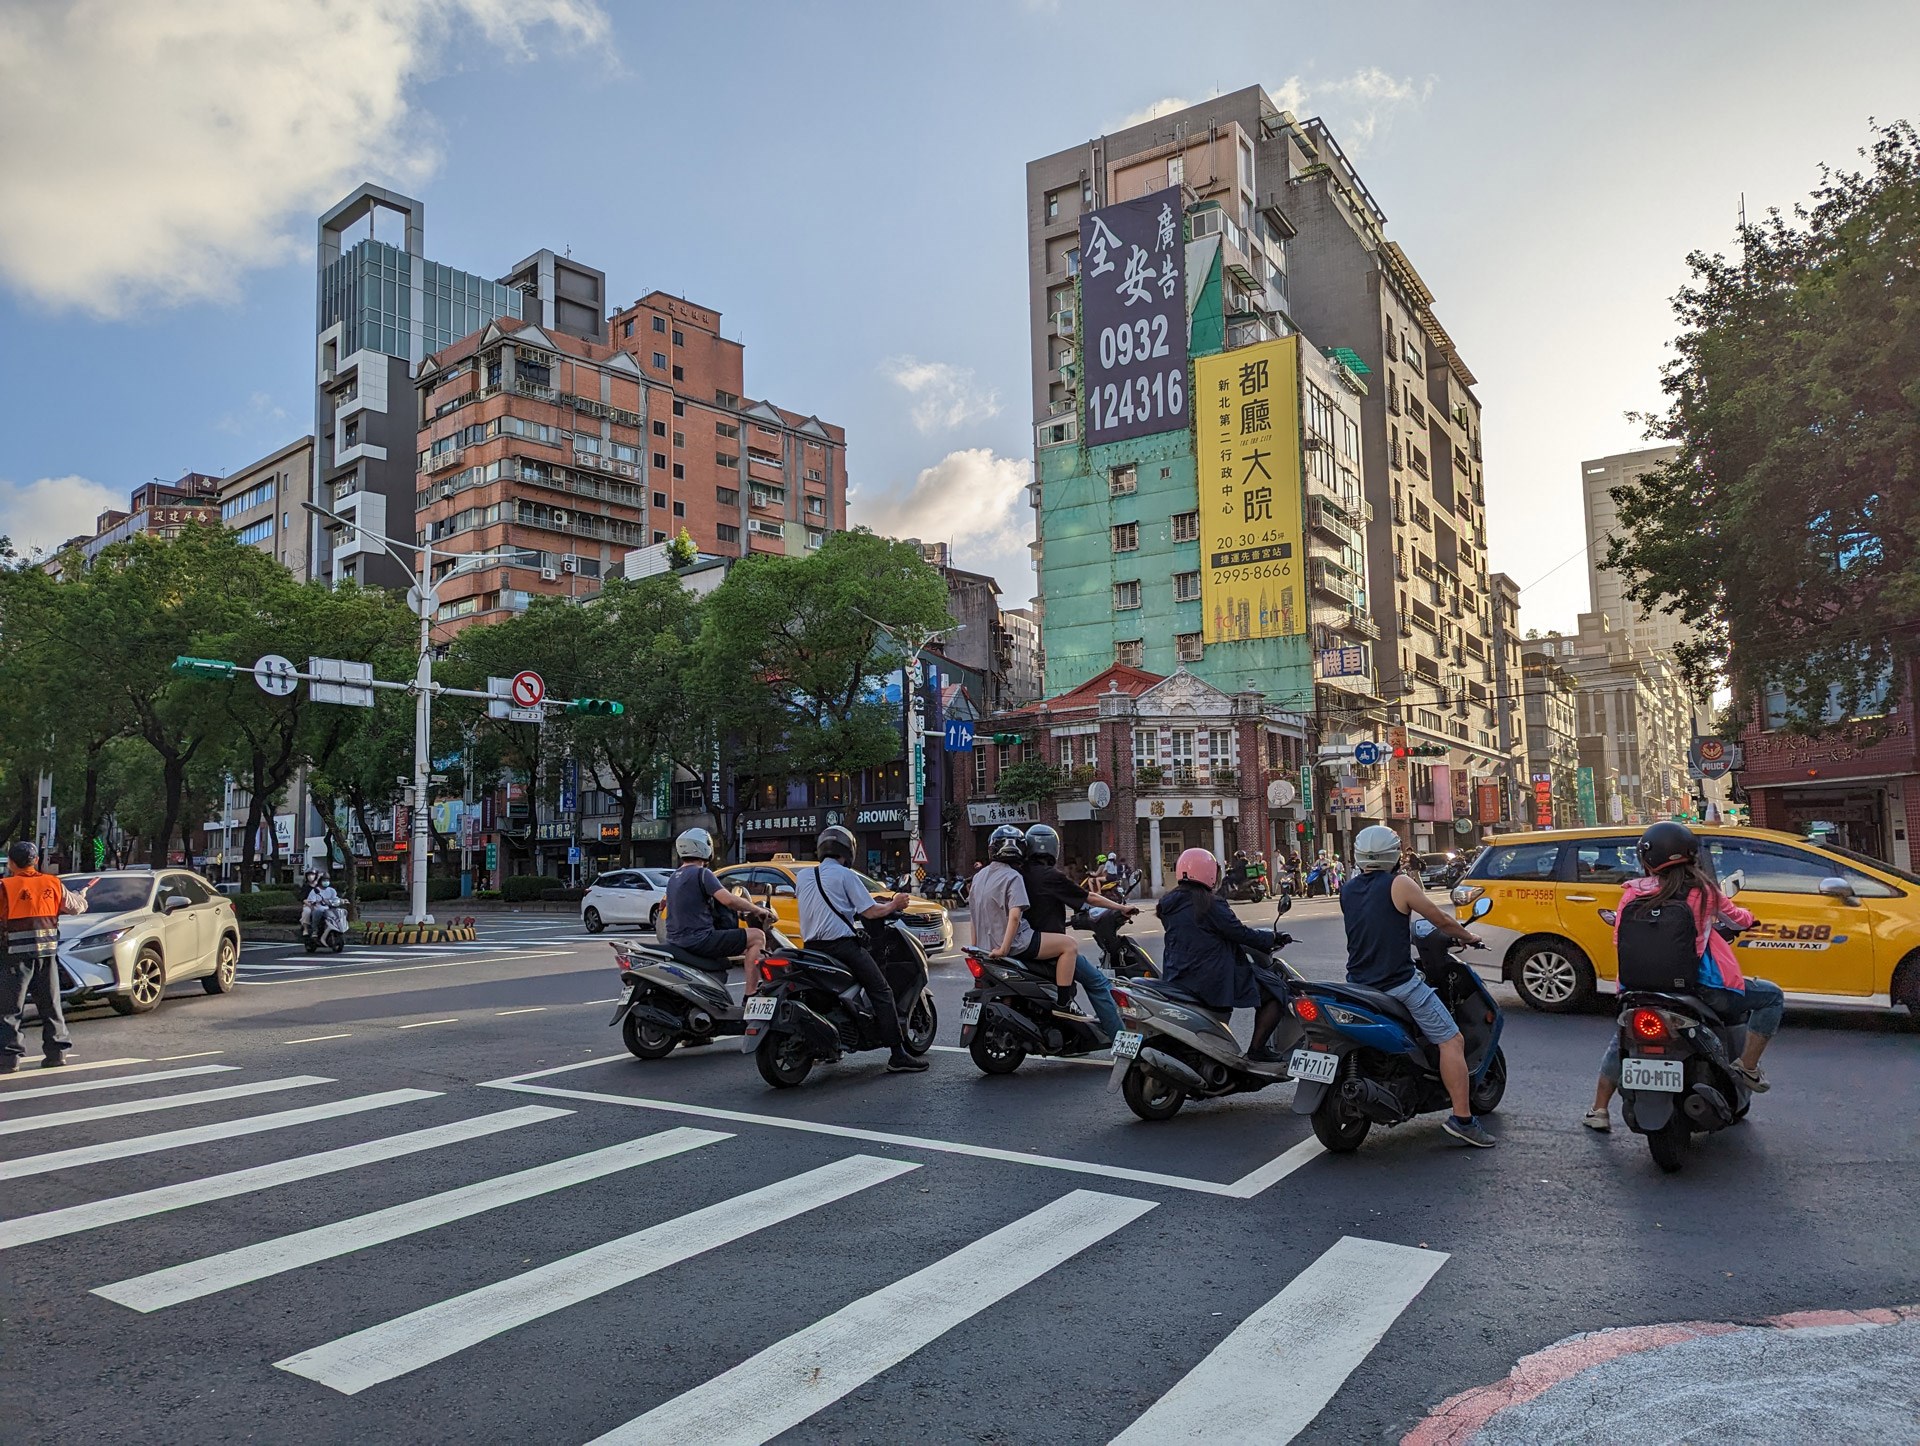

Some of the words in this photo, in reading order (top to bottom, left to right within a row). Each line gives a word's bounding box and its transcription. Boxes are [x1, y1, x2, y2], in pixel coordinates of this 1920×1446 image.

[1085, 216, 1156, 306] 全安
[1155, 203, 1179, 300] 廣告
[1100, 314, 1169, 369] 0932
[1090, 368, 1183, 431] 124316
[1218, 379, 1234, 515] 新北第二行政中心
[1239, 359, 1272, 523] 都廳大院
[1220, 548, 1282, 565] 捷運先嗇宮站
[1214, 562, 1290, 585] 2995-8666
[1215, 613, 1241, 629] TOP
[1259, 609, 1289, 625] CITY
[1323, 648, 1361, 677] 機車
[1702, 762, 1725, 770] POLICE
[1516, 889, 1554, 900] TDF-9585
[1755, 941, 1795, 949] TAIWAN
[1291, 1056, 1336, 1077] MFV-7117
[1624, 1069, 1682, 1088] 870-MTR
